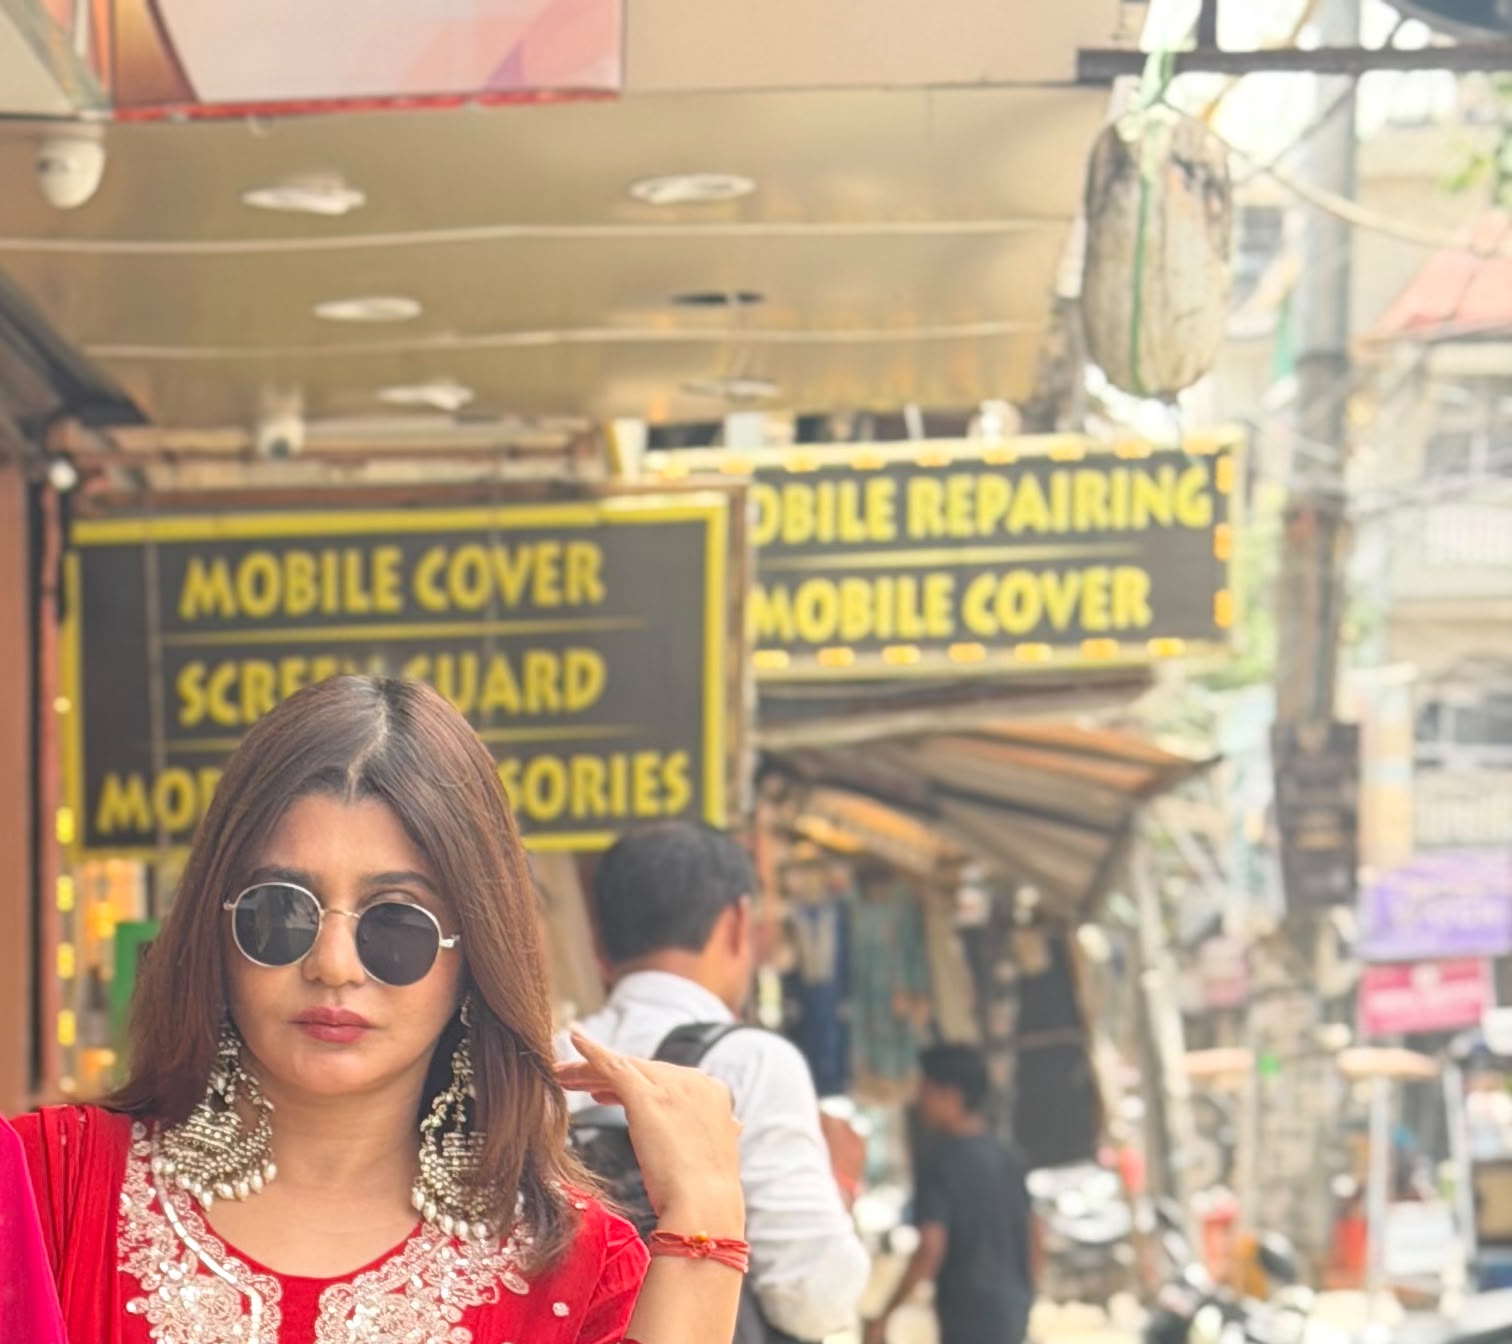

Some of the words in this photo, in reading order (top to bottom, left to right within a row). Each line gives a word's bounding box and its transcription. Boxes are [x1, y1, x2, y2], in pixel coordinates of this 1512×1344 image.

[749, 476, 898, 547] OBILE
[906, 464, 1214, 541] REPAIRING
[179, 545, 404, 621] MOBILE
[414, 539, 607, 613] COVER
[744, 572, 957, 643] MOBILE
[962, 565, 1154, 635] COVER
[175, 655, 386, 728] SCRE
[402, 647, 607, 717] UARD
